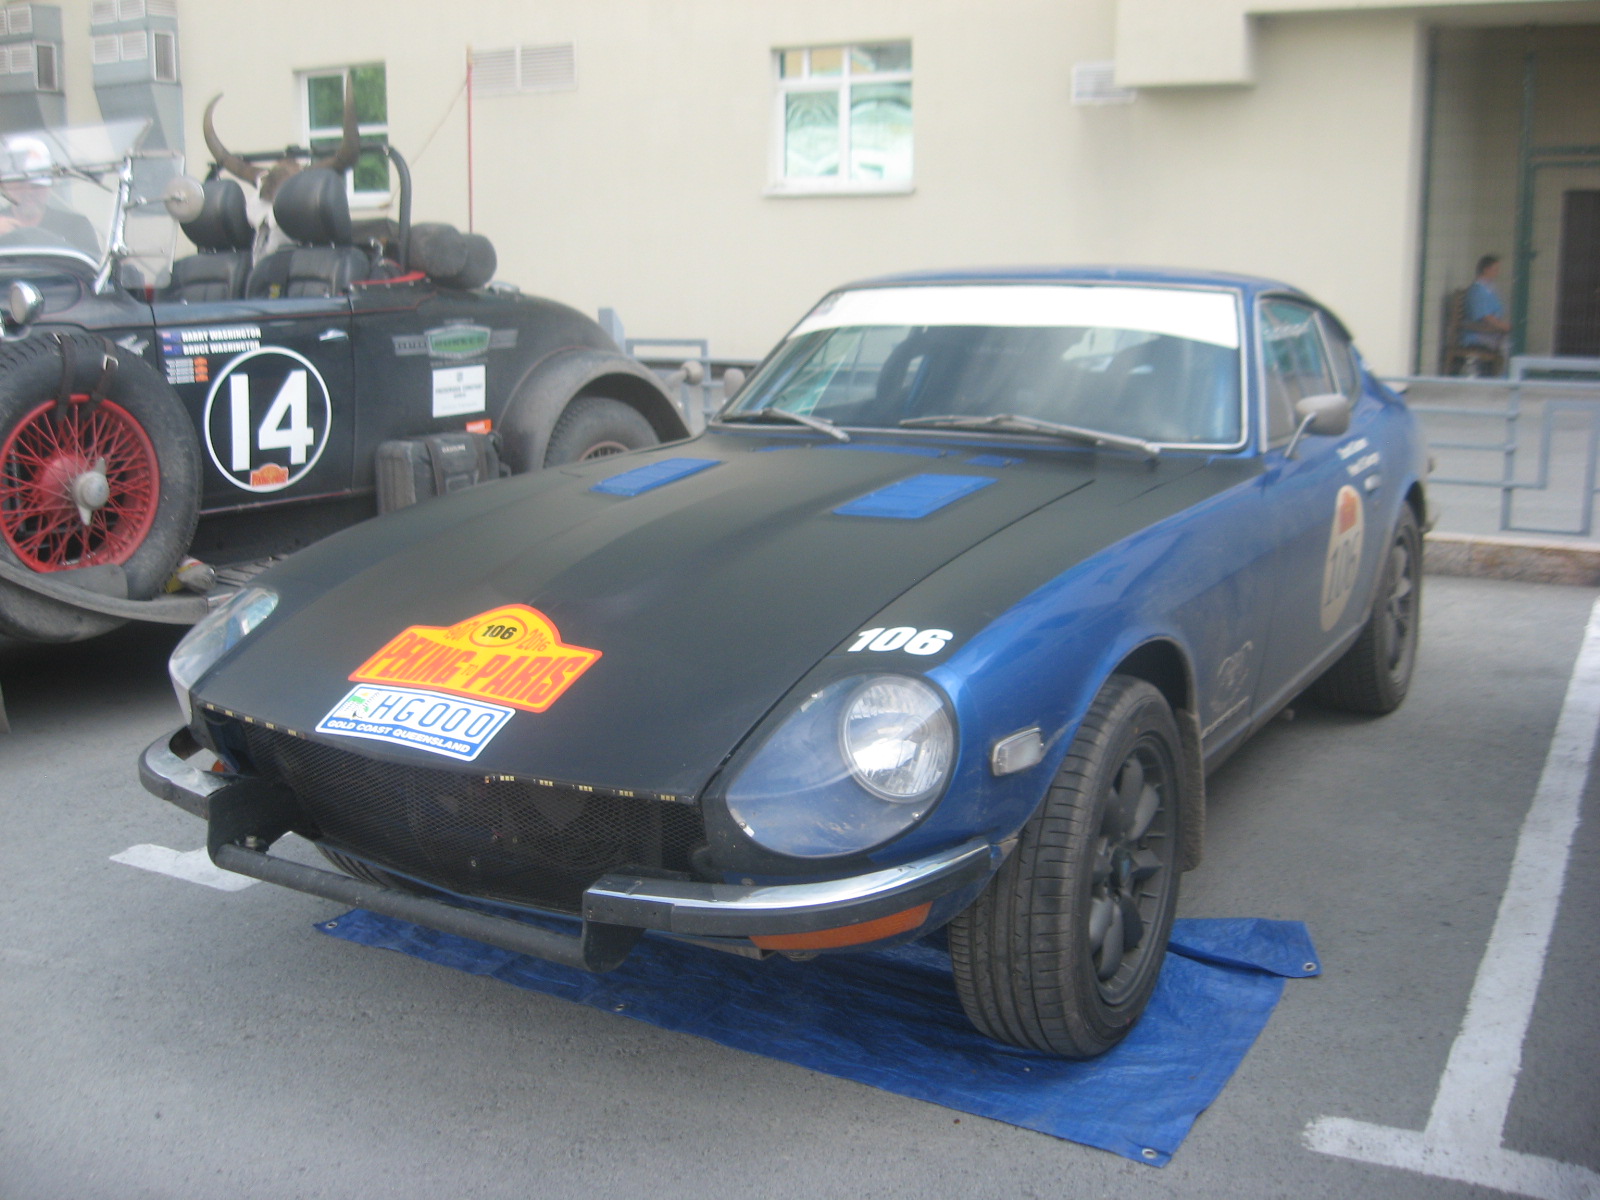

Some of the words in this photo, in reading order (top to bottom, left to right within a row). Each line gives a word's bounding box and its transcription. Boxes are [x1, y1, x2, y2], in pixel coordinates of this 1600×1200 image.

[209, 326, 261, 341] WASHINGTON
[209, 340, 260, 354] WASHINGTON
[230, 370, 314, 472] 14
[482, 625, 517, 639] 106
[515, 628, 551, 652] 2016
[847, 626, 954, 656] 106
[361, 631, 477, 684] PEKING
[461, 663, 478, 676] TO
[461, 654, 588, 704] PARIS
[327, 719, 356, 730] GOLD
[356, 723, 393, 735] COAST
[392, 728, 471, 753] QUEENSLAND
